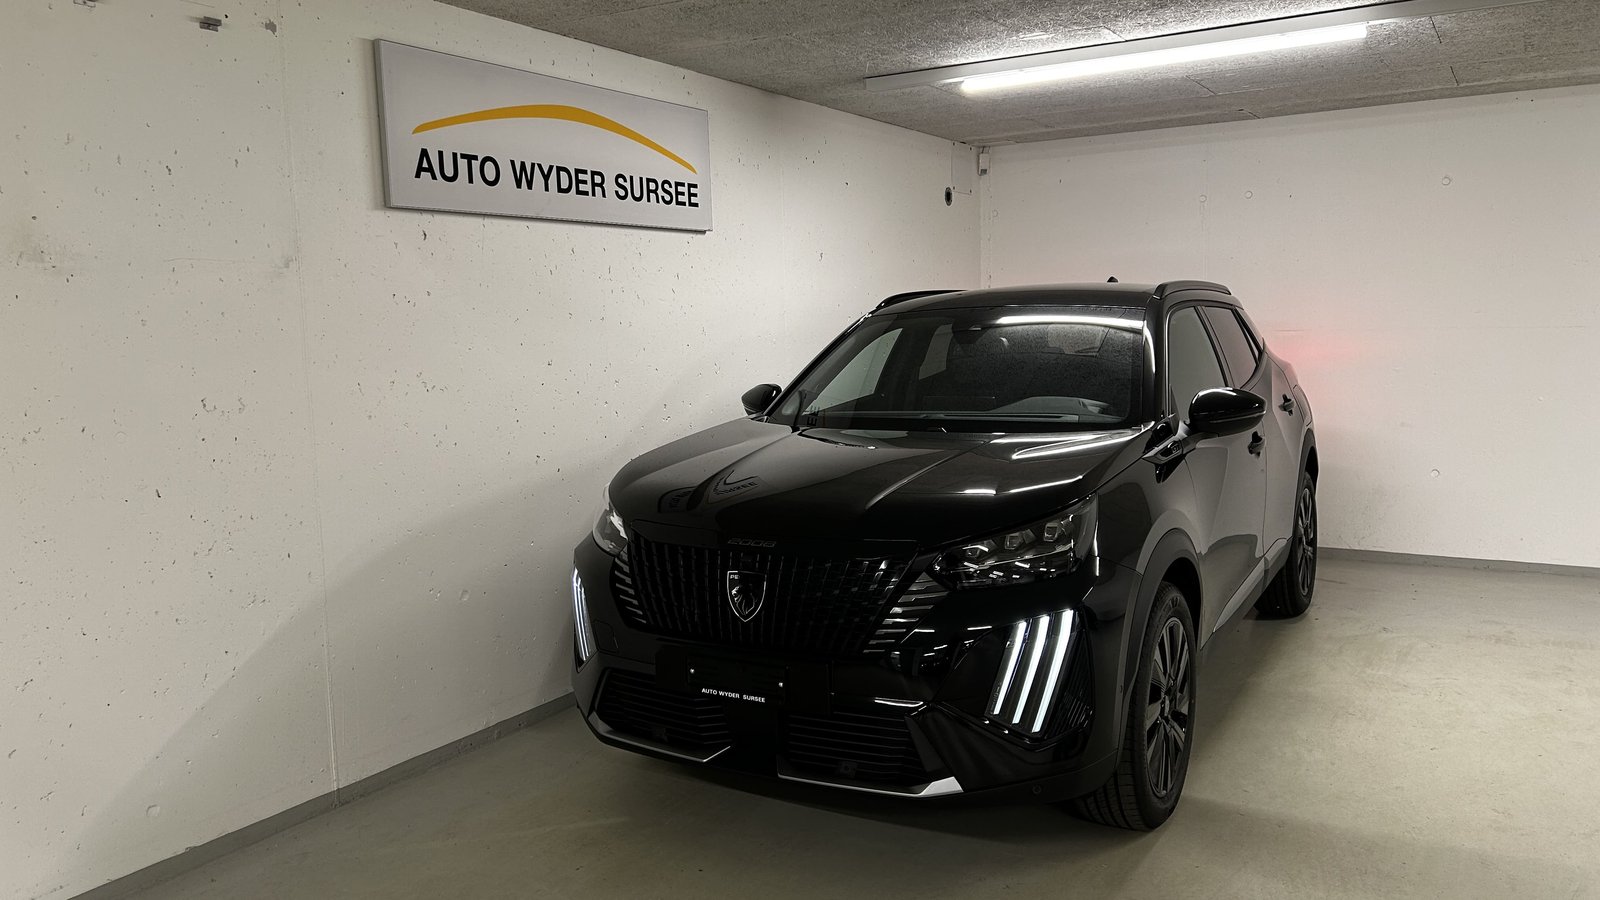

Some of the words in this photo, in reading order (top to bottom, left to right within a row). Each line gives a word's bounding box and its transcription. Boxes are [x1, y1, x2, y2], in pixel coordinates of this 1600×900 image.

[414, 147, 501, 187] AUTO
[509, 159, 607, 199] WYDER
[614, 173, 700, 208] SURSEE
[701, 687, 718, 696] AUTO
[718, 690, 740, 699] WYDER
[742, 694, 766, 703] SURSEE
